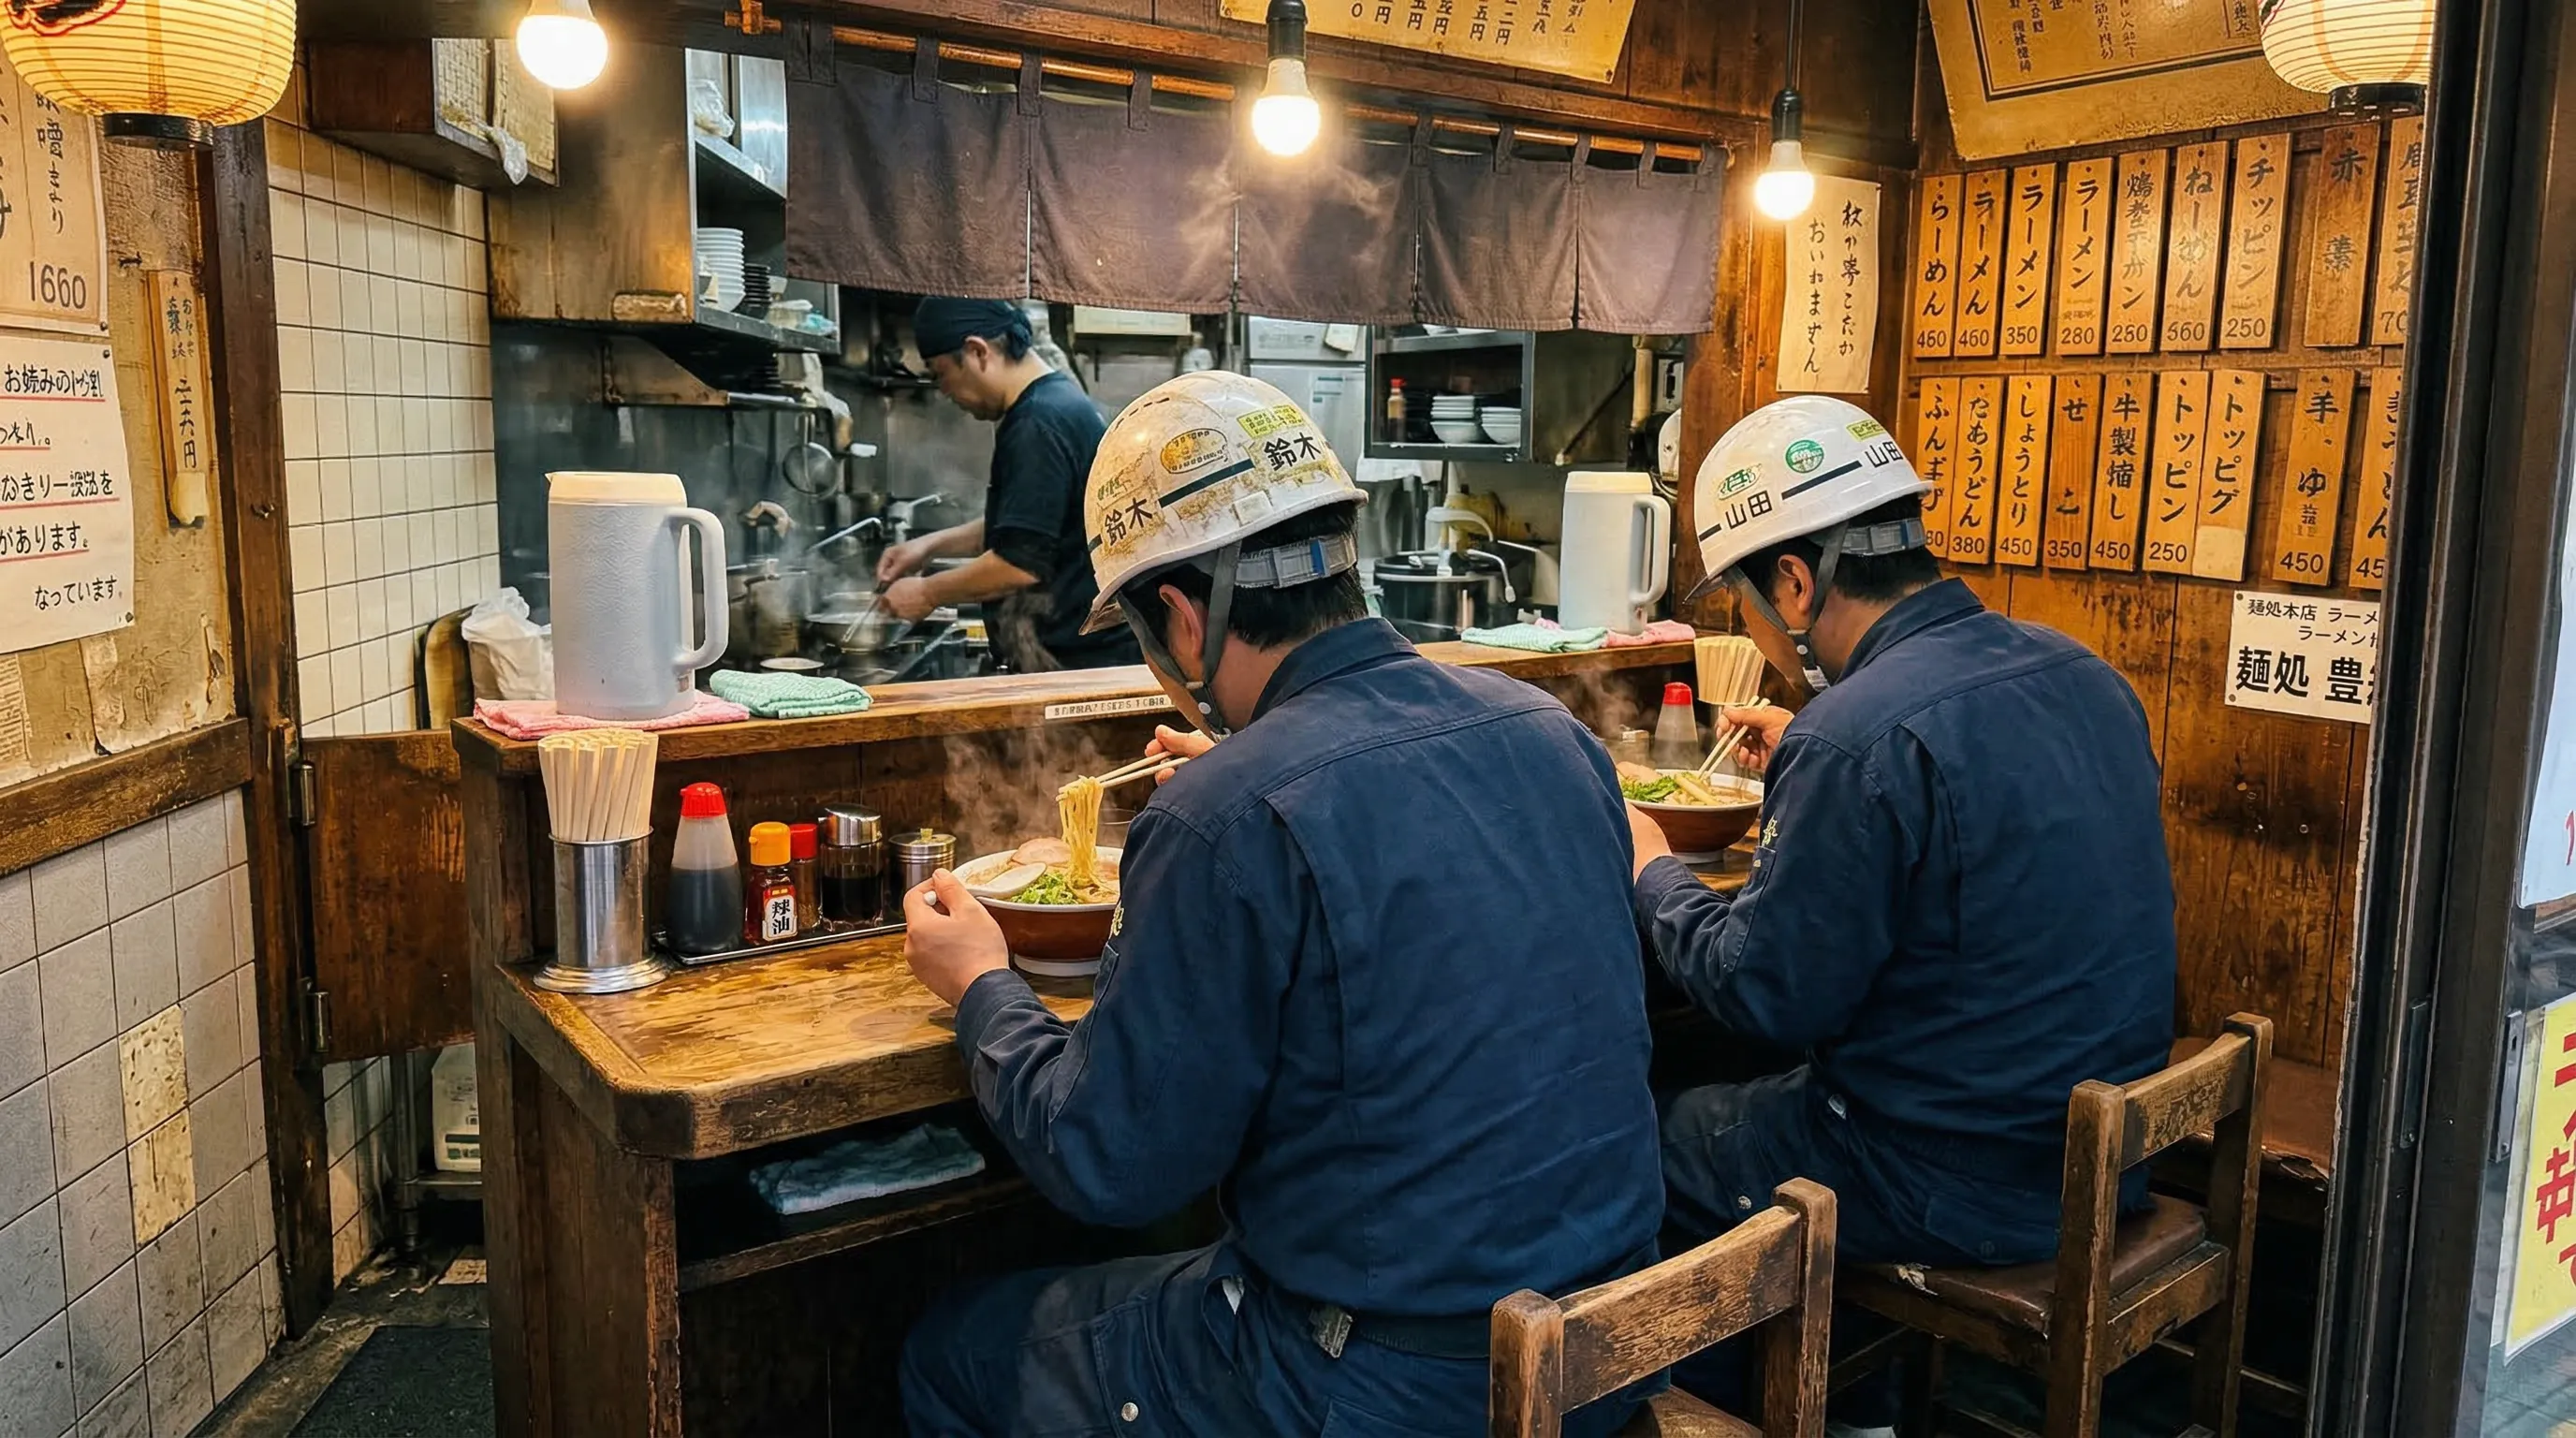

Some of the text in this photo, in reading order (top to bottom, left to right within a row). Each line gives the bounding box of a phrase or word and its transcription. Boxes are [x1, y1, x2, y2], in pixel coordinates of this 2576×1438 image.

[1374, 0, 1394, 24] 円
[2071, 179, 2100, 290] ラーメン
[2236, 157, 2275, 289] チッピン
[1922, 193, 1950, 317] らーめん
[2014, 184, 2044, 310] ラーメン
[29, 260, 87, 310] 1660
[2005, 325, 2038, 345] 350
[2060, 327, 2095, 345] 280
[2224, 317, 2266, 338] 250
[1263, 431, 1322, 472] 鈴木
[1864, 441, 1904, 469] 山田
[2011, 393, 2036, 528] しょうとり
[2159, 393, 2195, 523] トッピン
[2208, 392, 2246, 515] トッピグ
[1104, 496, 1153, 547] 鈴木
[1725, 490, 1773, 530] 山田
[1952, 536, 1985, 554] 380
[1999, 536, 2032, 556] 450
[2047, 540, 2083, 559] 350
[2095, 540, 2131, 561] 450
[2148, 541, 2188, 563] 250
[2279, 550, 2324, 574] 450
[35, 574, 123, 610] なっています。
[2235, 645, 2310, 698] 麺処
